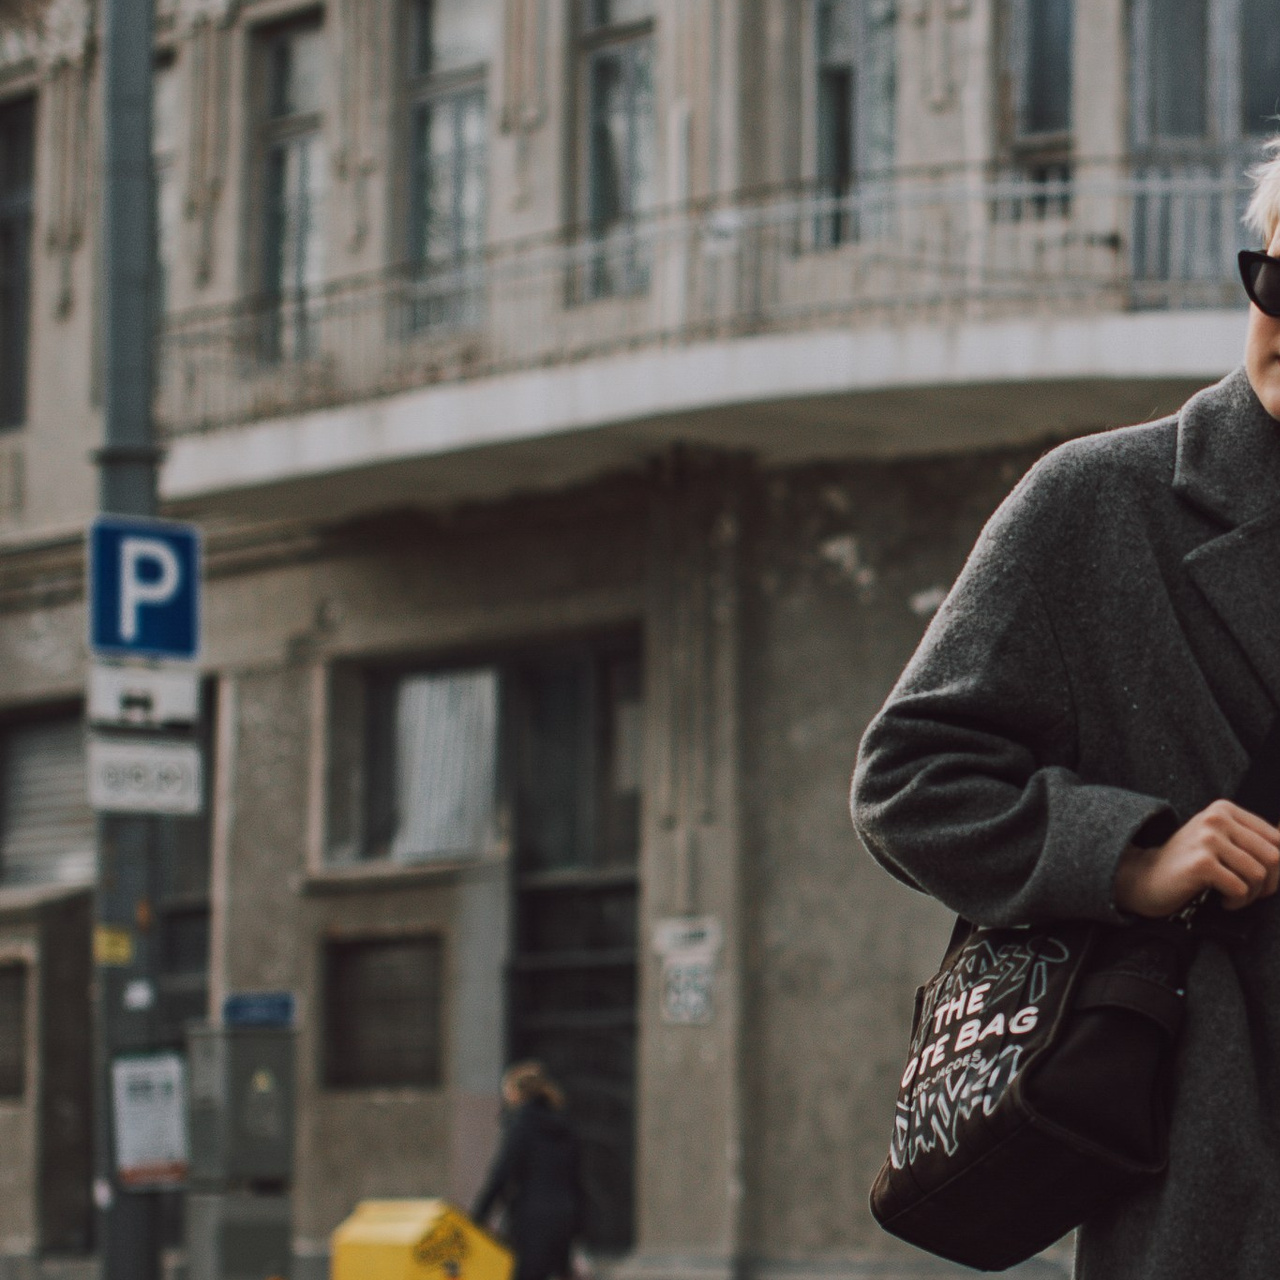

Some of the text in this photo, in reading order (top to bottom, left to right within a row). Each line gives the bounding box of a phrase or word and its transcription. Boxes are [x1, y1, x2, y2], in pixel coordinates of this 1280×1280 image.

[119, 537, 180, 641] P
[901, 1006, 1039, 1089] OTE BAG
[934, 982, 991, 1034] THE
